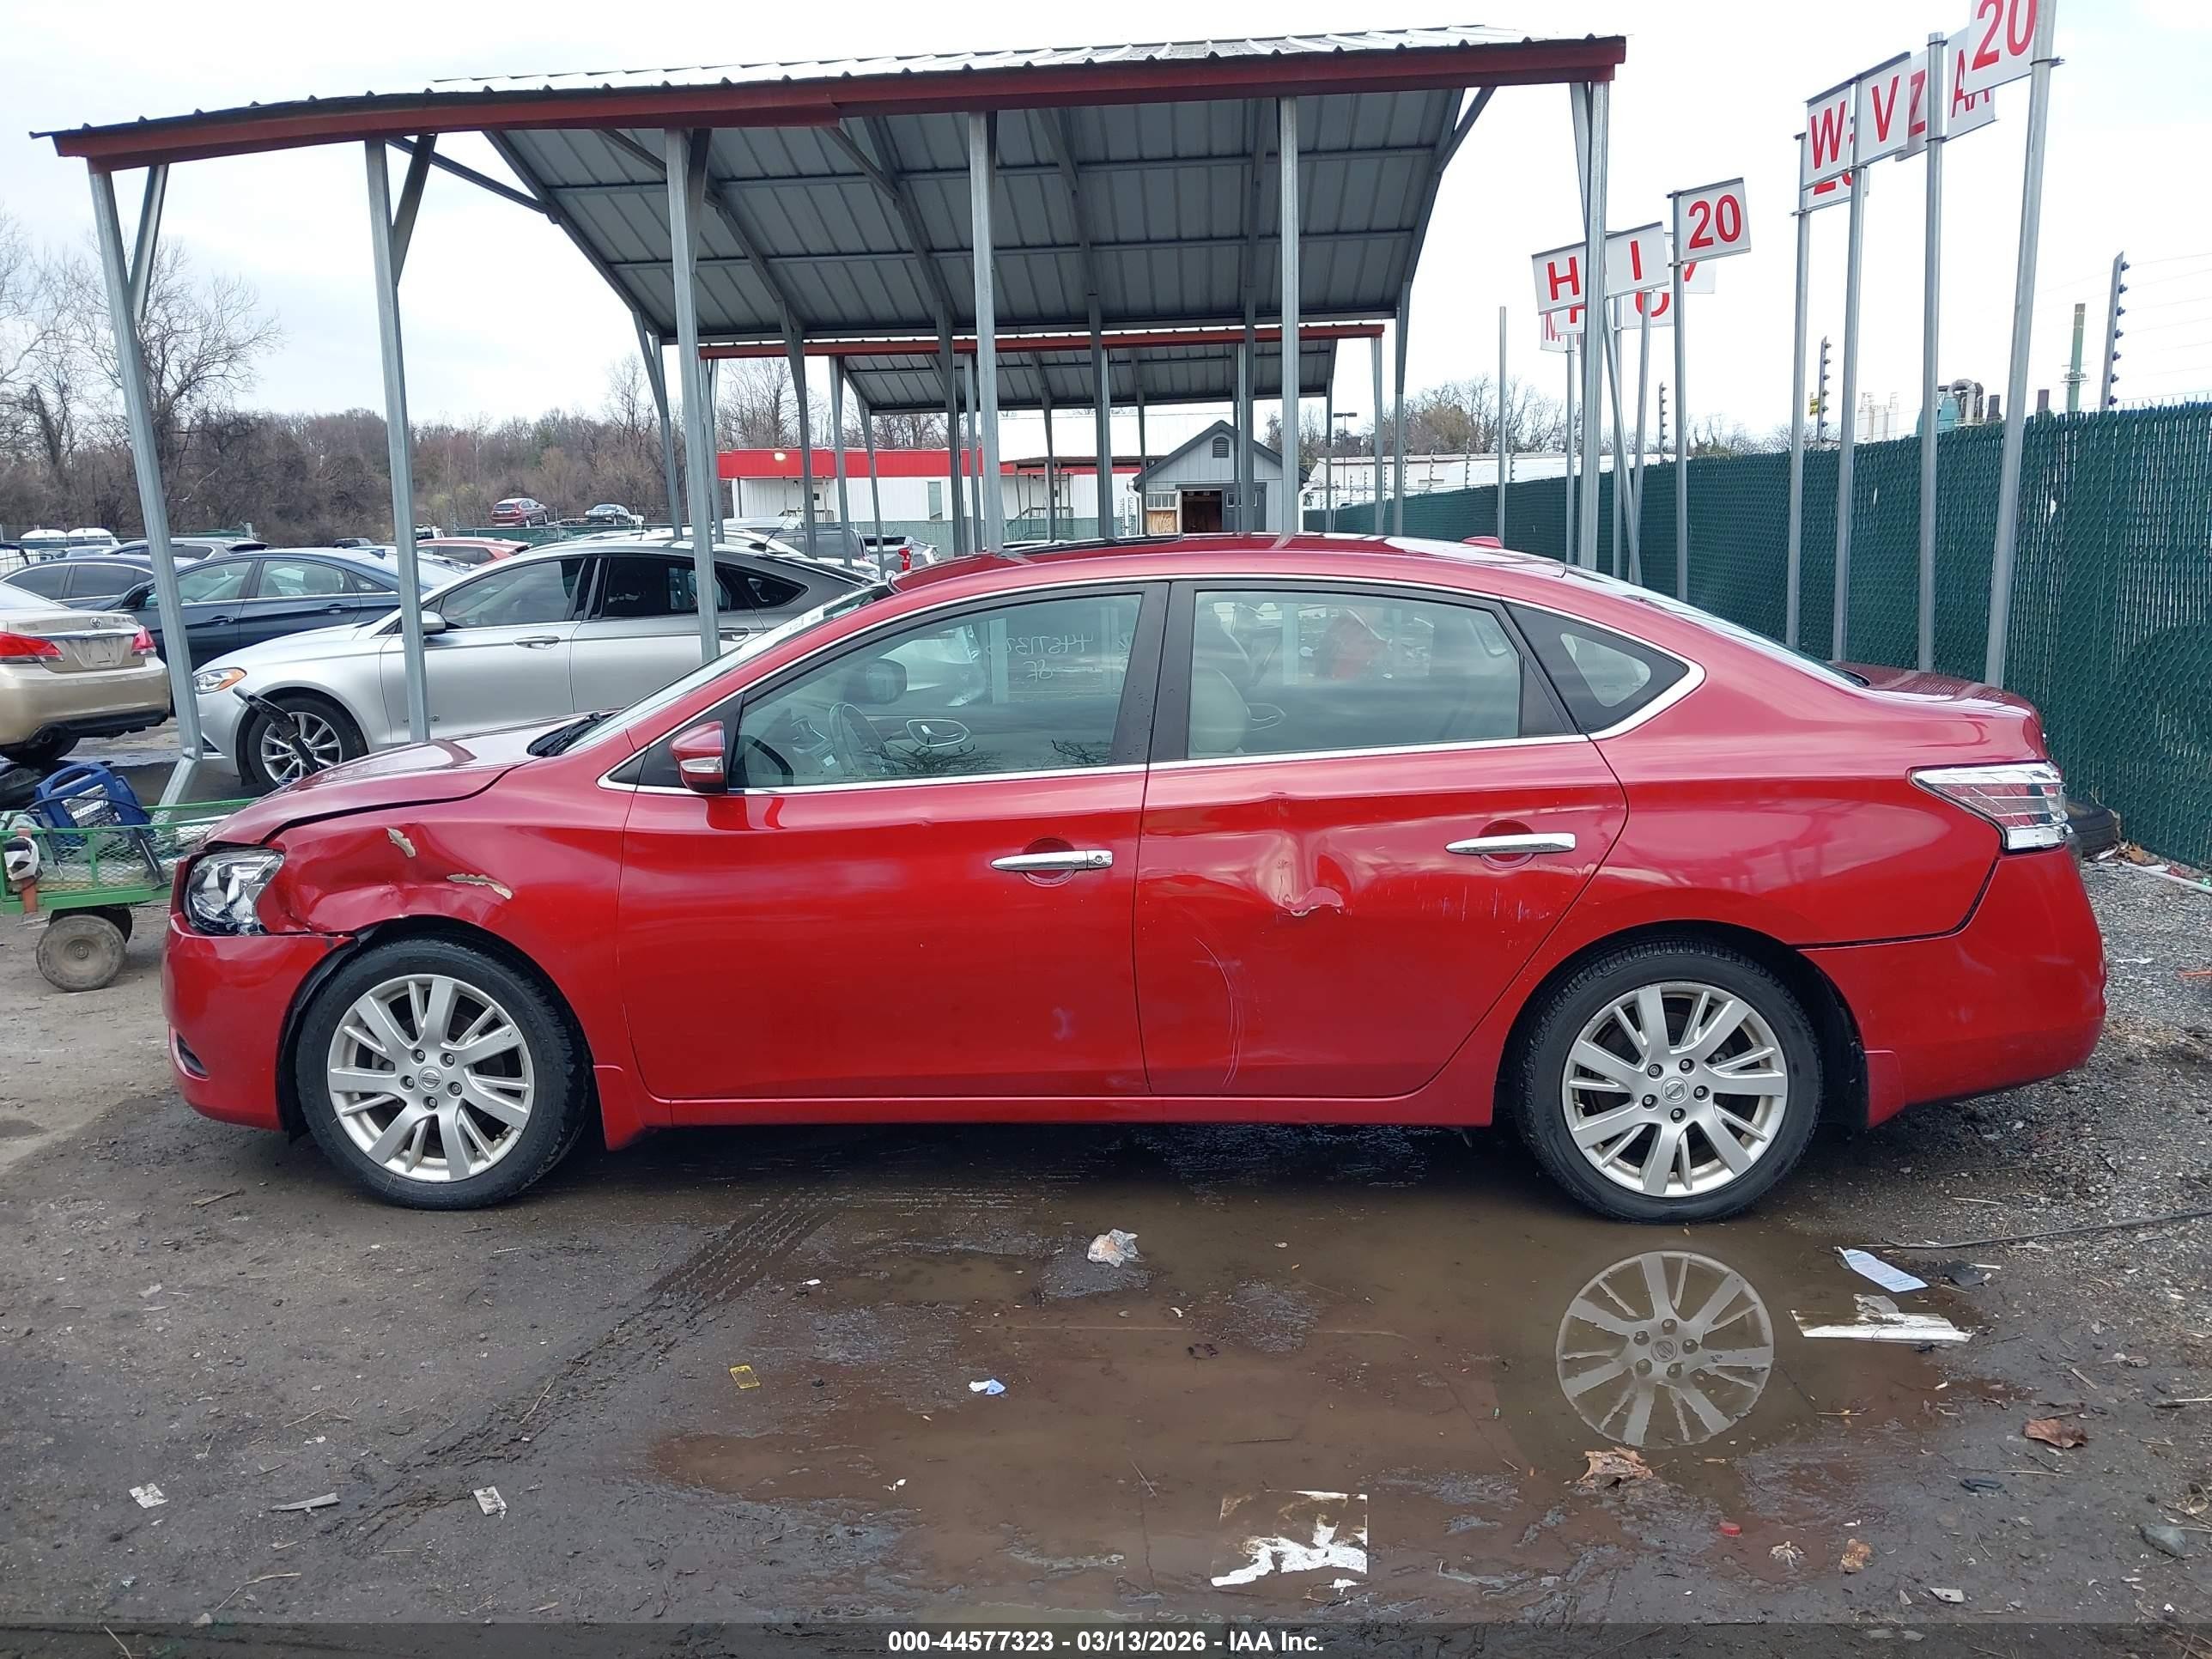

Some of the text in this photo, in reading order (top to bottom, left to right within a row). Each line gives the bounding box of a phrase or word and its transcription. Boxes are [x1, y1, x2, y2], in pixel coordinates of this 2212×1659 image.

[1972, 0, 2038, 70] 20
[1810, 100, 1847, 170] W
[1871, 75, 1900, 143] V
[1688, 194, 1741, 249] 20
[1547, 257, 1580, 301] H
[1630, 240, 1642, 281] I
